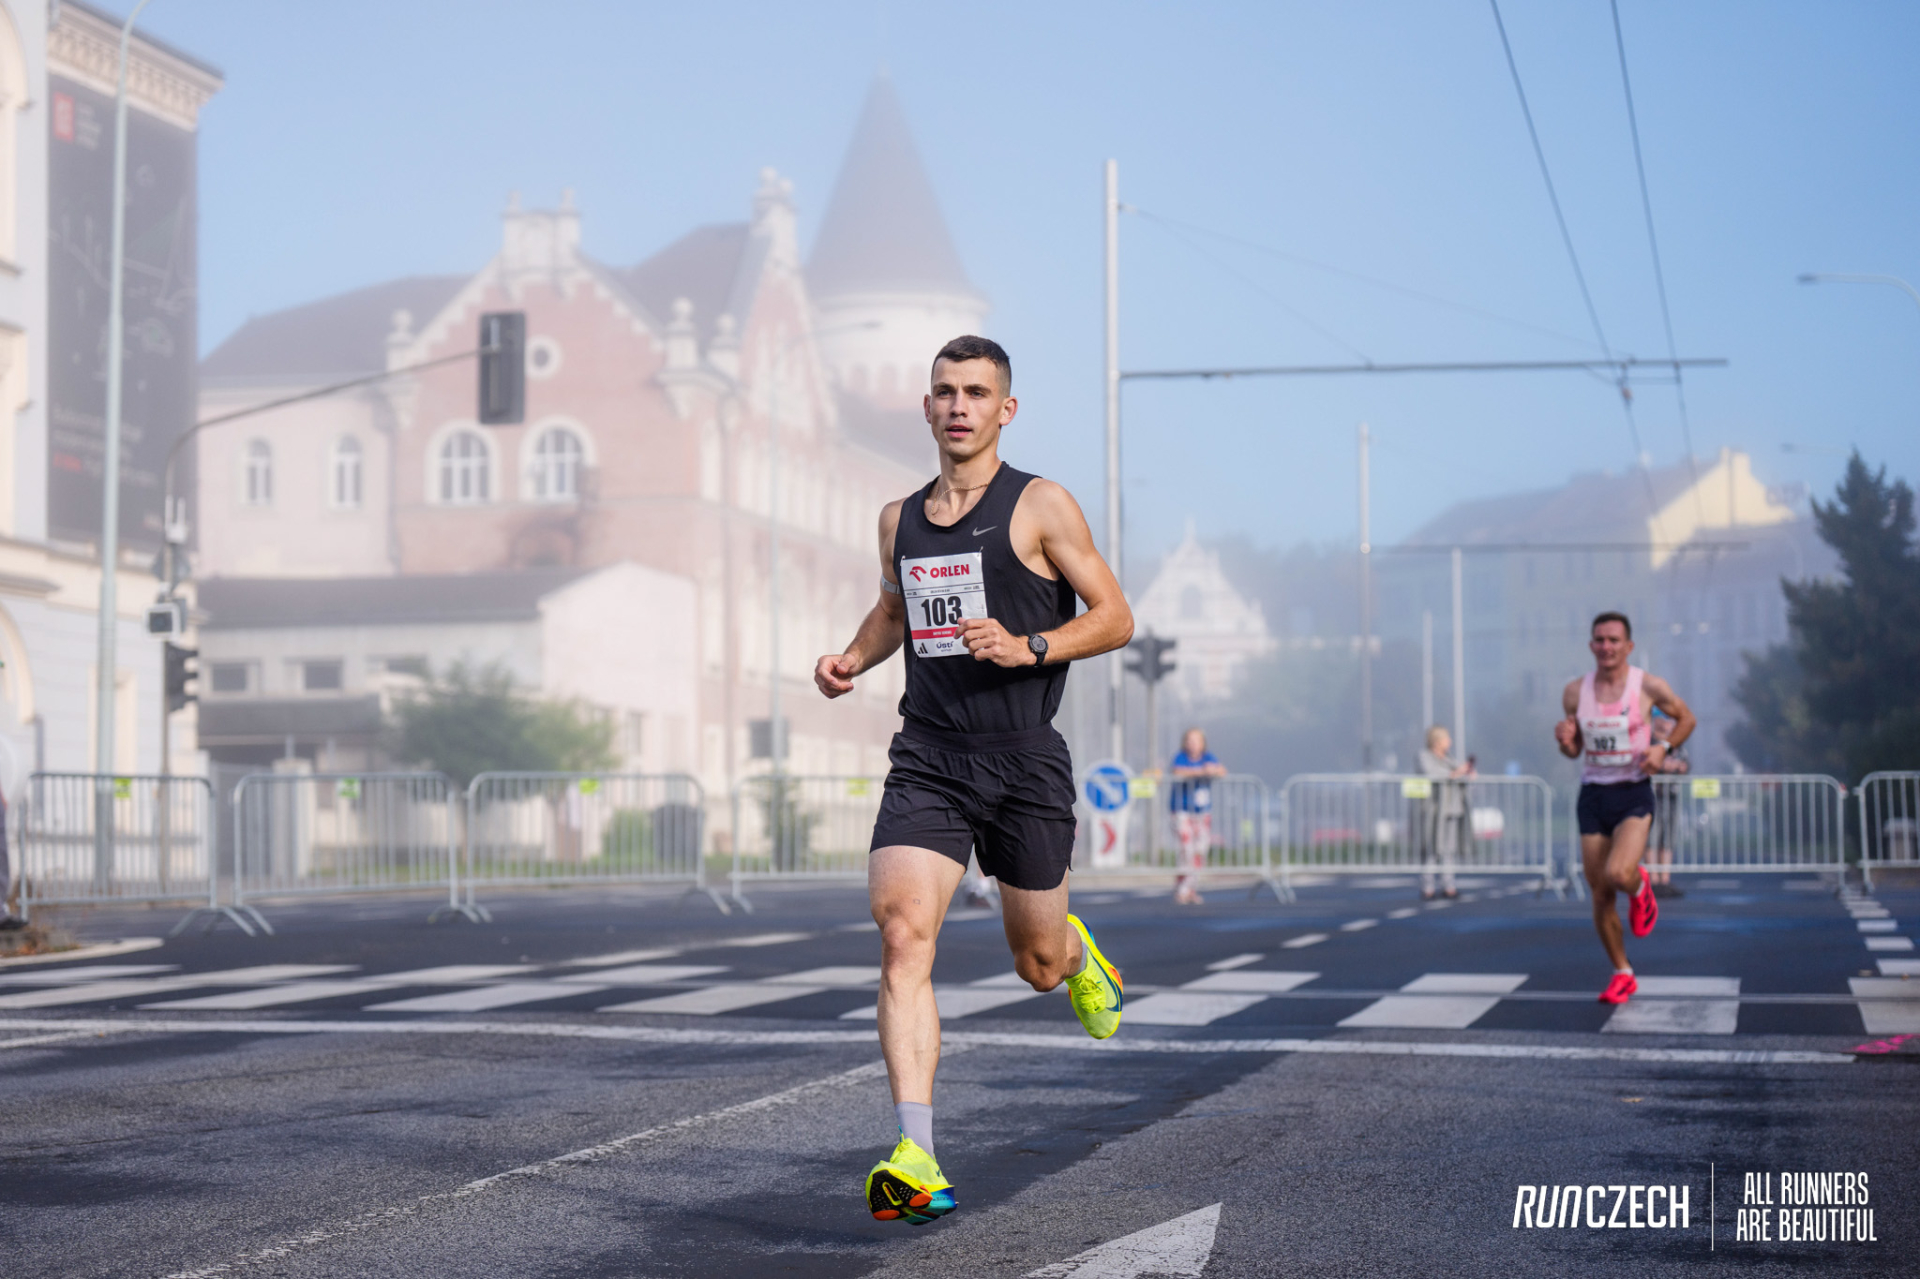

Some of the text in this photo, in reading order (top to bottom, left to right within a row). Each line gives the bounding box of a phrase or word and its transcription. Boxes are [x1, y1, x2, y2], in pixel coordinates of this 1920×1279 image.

[930, 564, 970, 578] ORLEN
[921, 595, 963, 627] 103
[1594, 736, 1616, 750] 102
